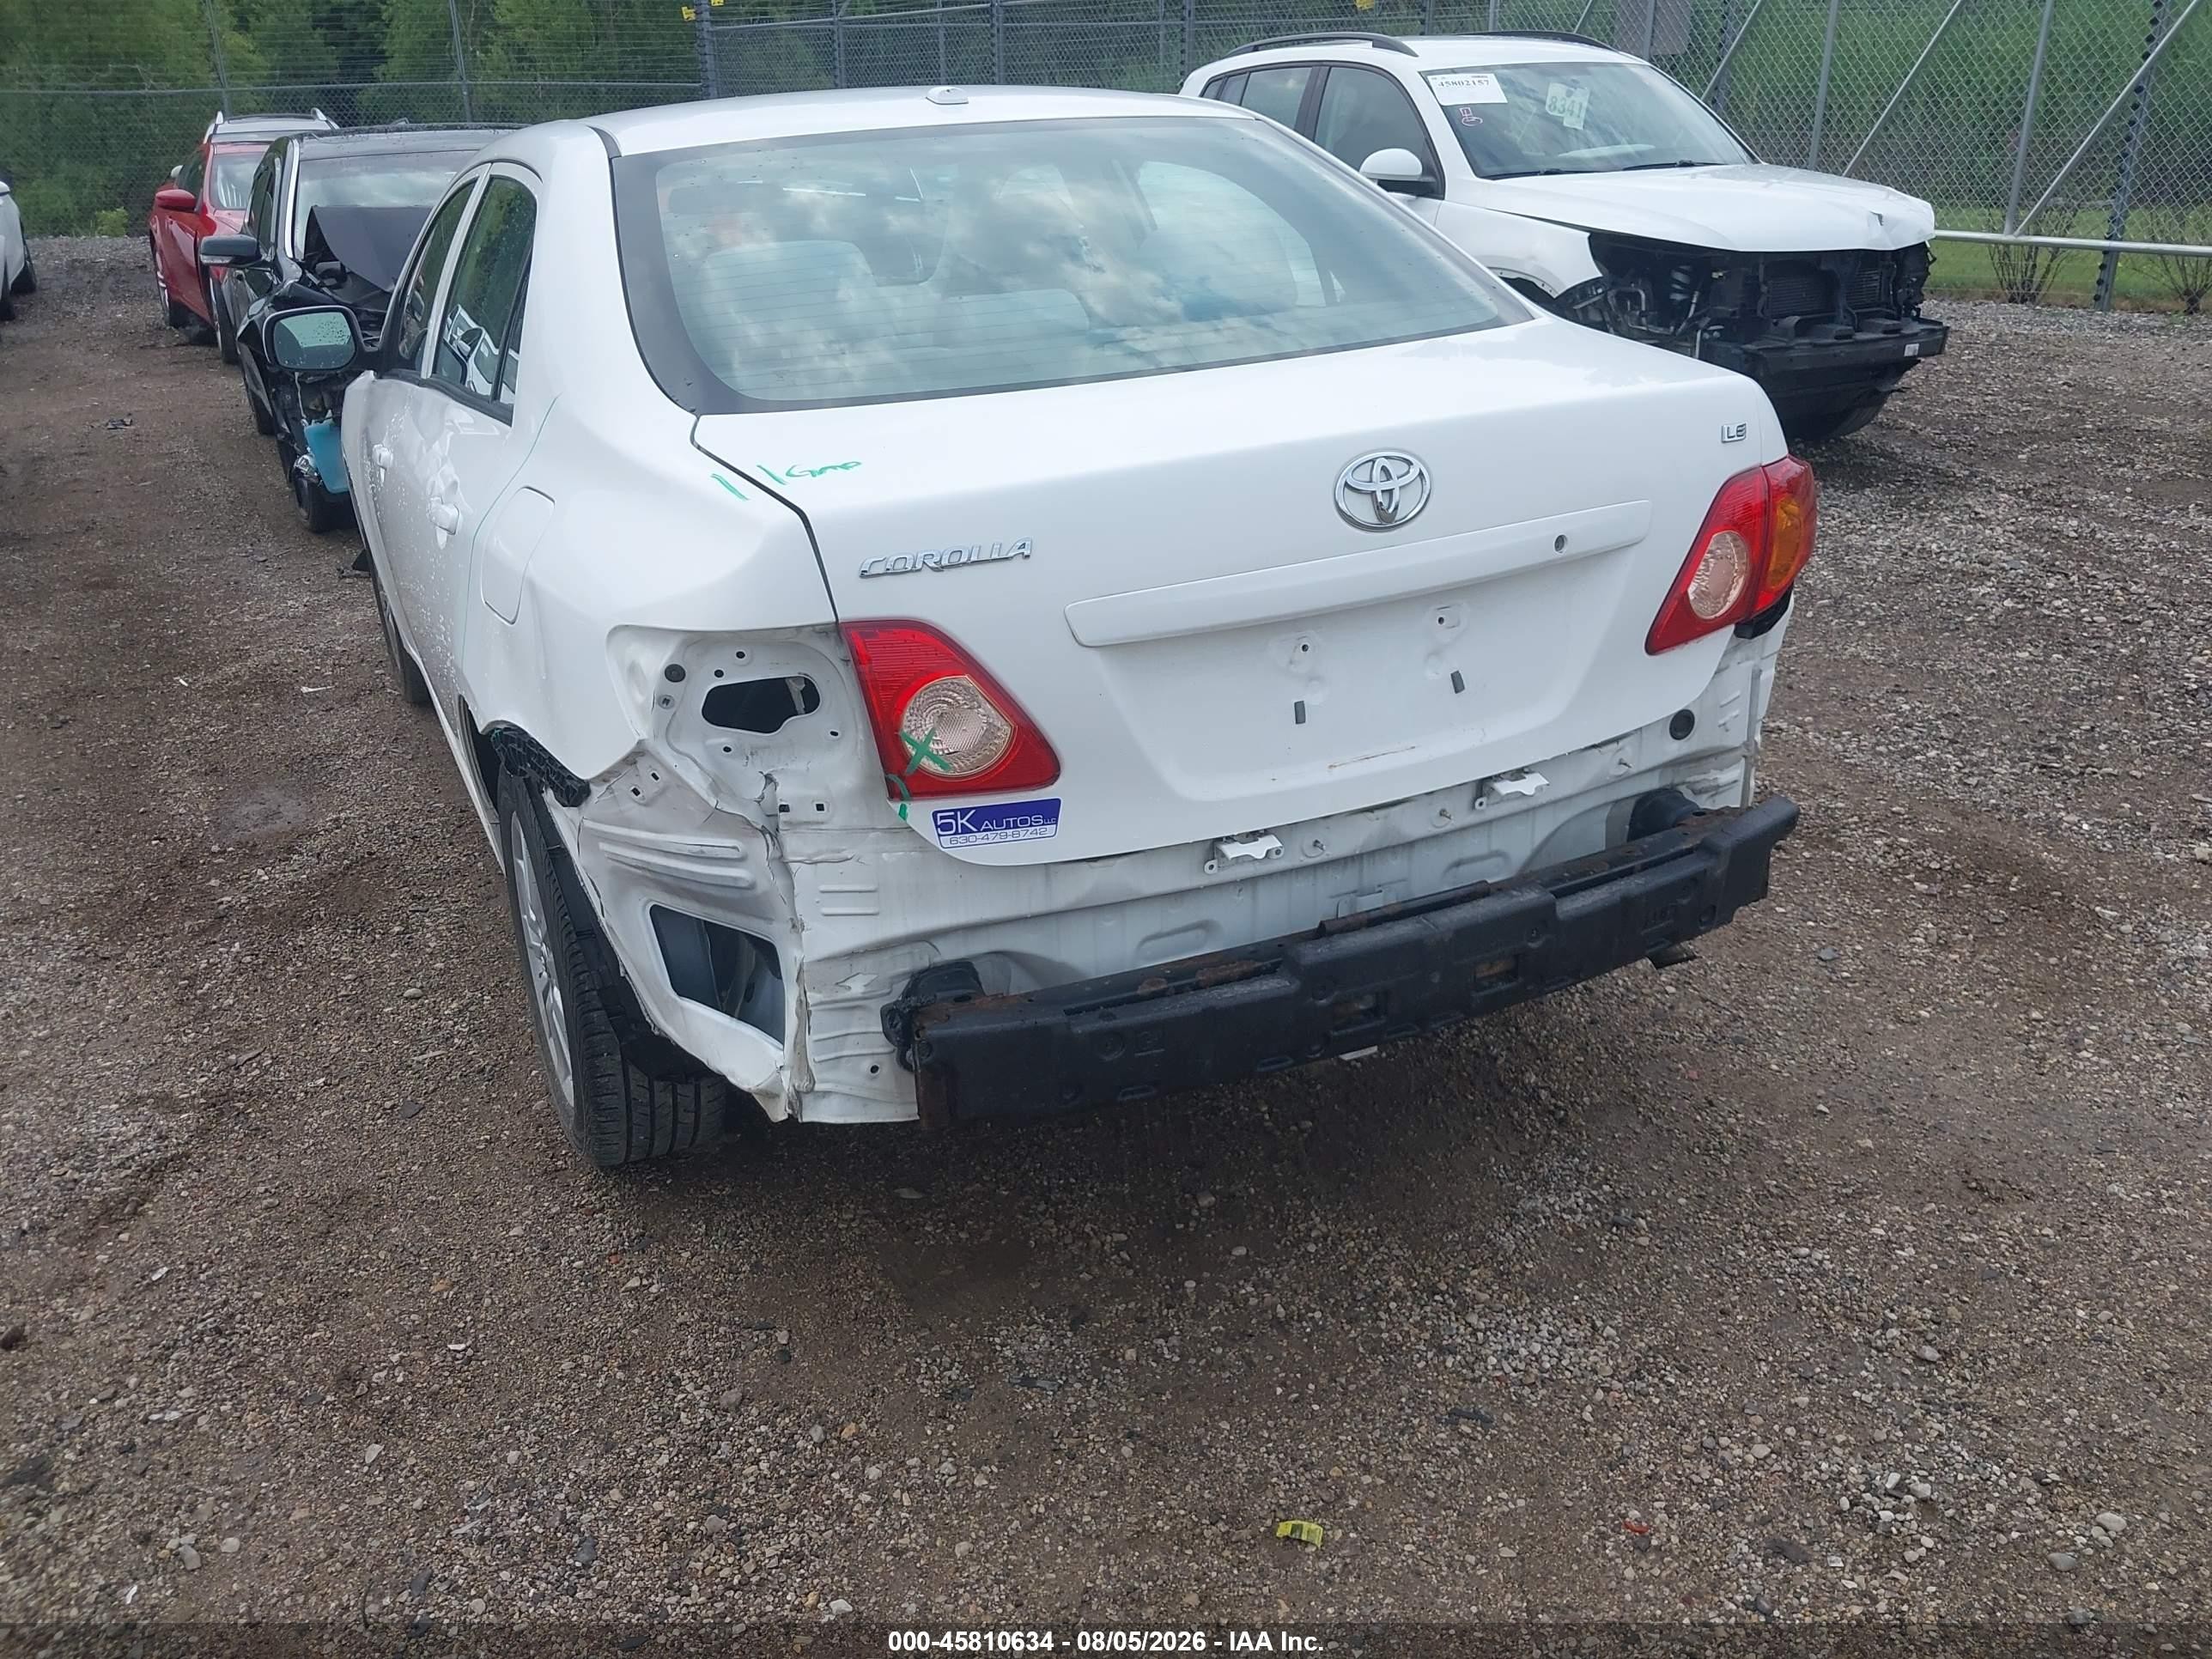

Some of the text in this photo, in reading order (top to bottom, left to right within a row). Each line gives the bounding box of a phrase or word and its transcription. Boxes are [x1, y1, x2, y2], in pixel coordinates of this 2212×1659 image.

[1437, 79, 1490, 88] 45802157
[1548, 95, 1583, 118] 8341
[1722, 423, 1747, 443] LE
[859, 538, 1033, 579] COROLLA
[935, 810, 978, 836] 5K
[981, 815, 1043, 831] AUTOS
[949, 827, 1048, 845] 630-479-8742
